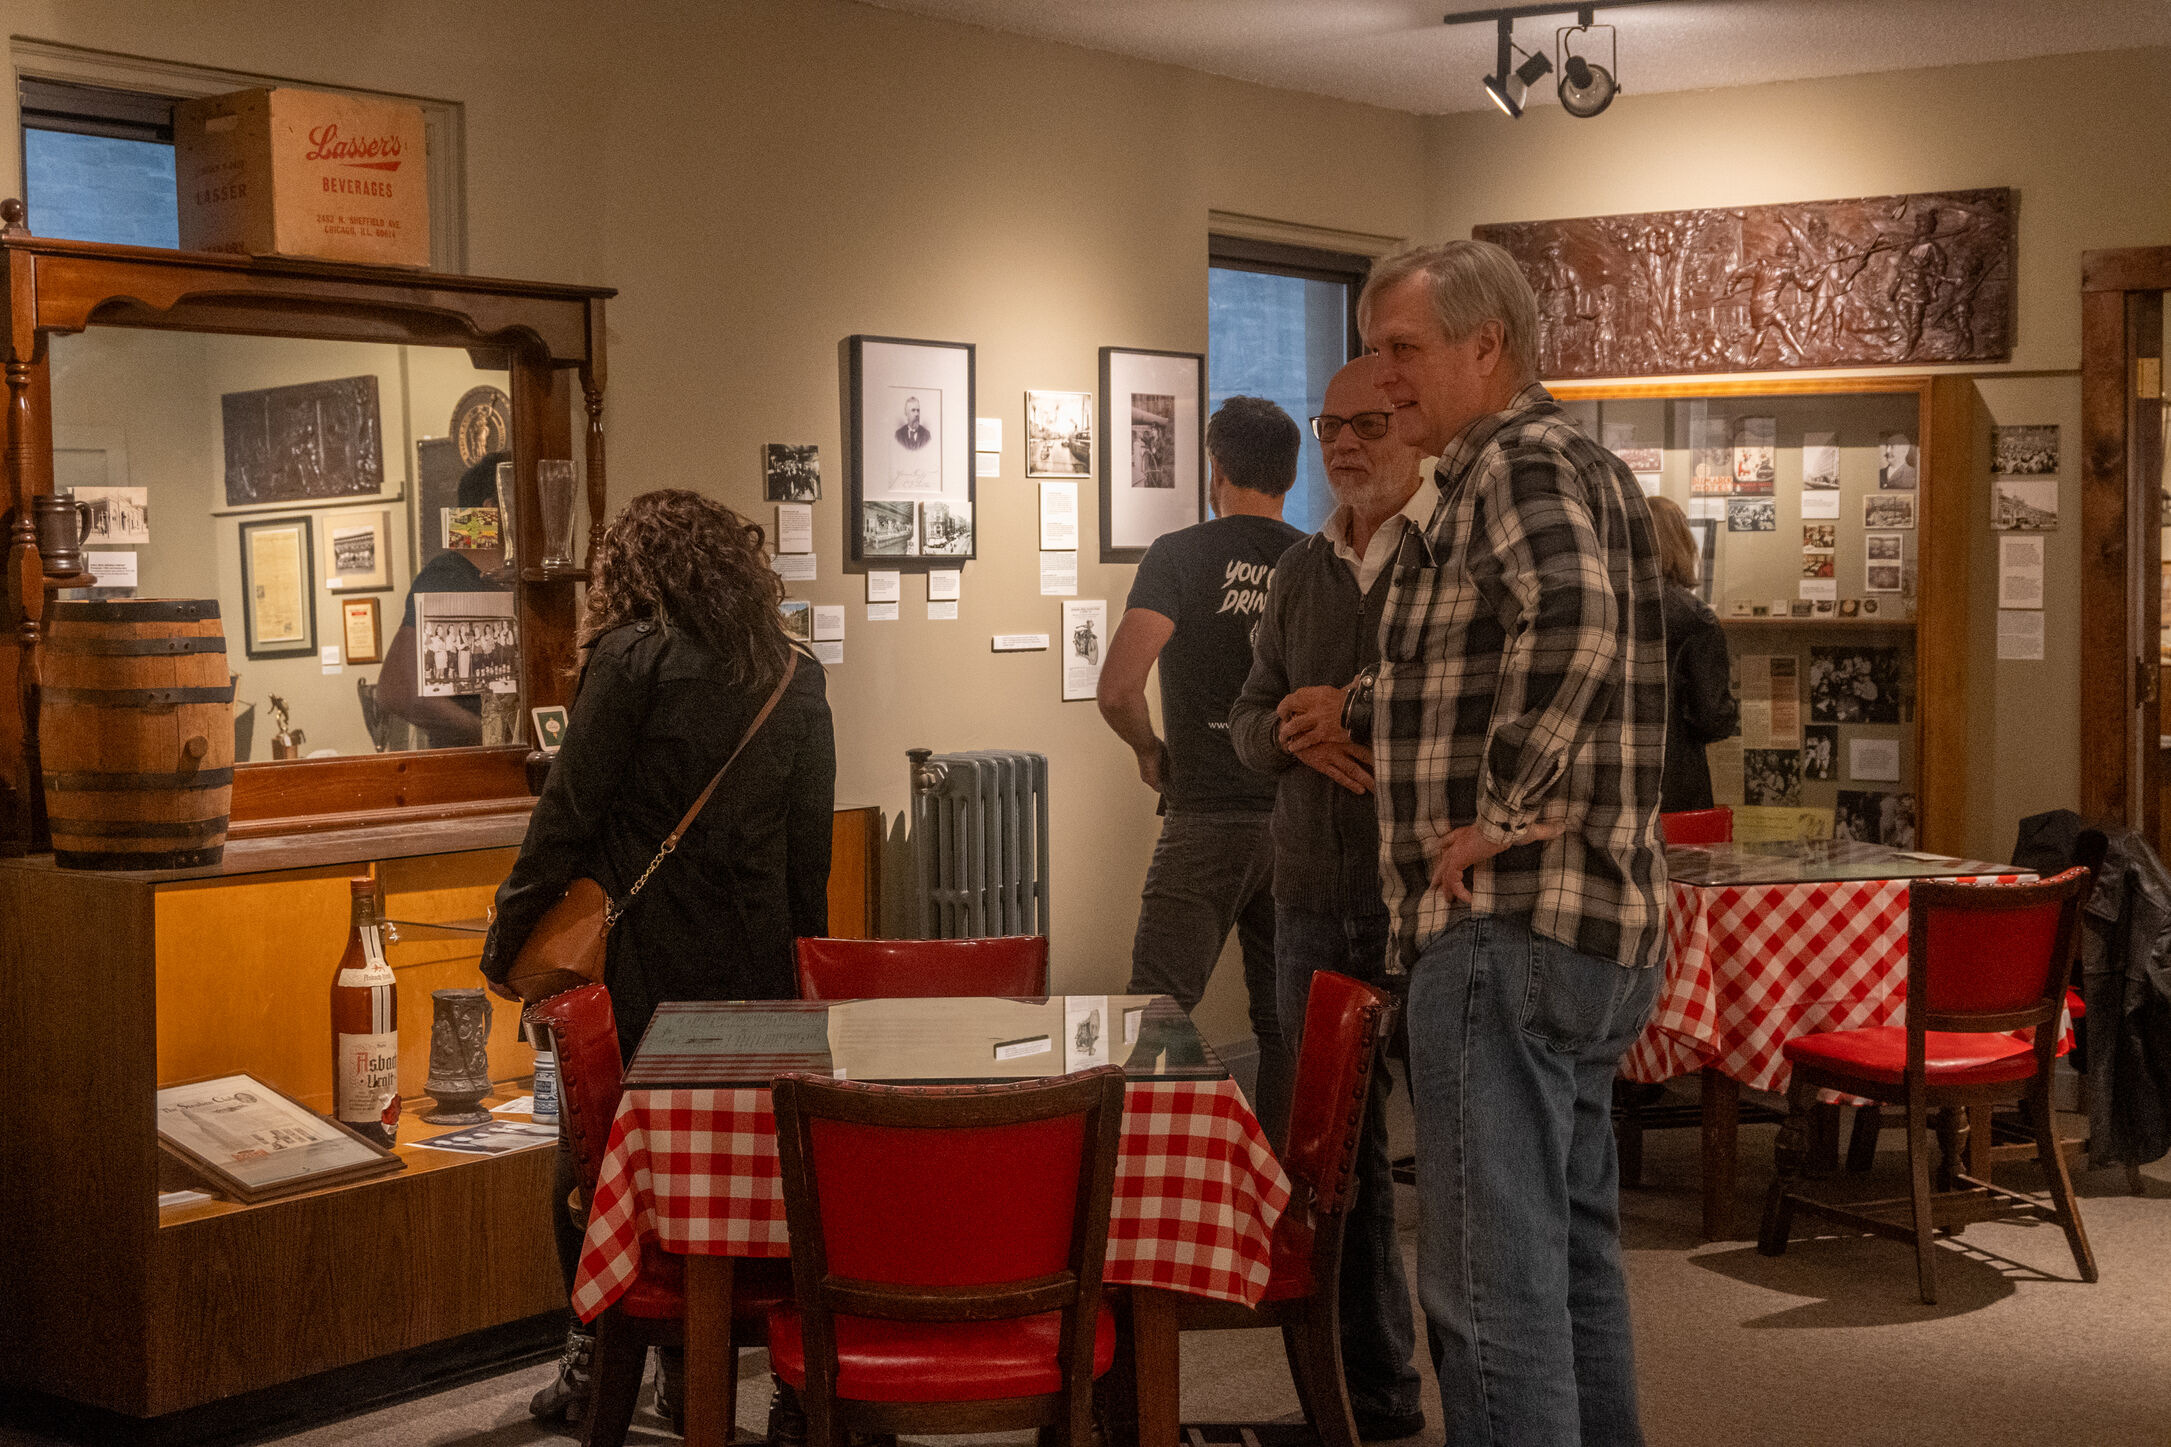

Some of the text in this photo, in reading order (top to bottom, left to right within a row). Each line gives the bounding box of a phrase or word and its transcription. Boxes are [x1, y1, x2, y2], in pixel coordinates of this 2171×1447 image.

[306, 124, 401, 160] Lasser's
[323, 177, 393, 198] BEVERAGES
[349, 216, 385, 227] SHEFFIELD
[1215, 589, 1267, 615] DRIN
